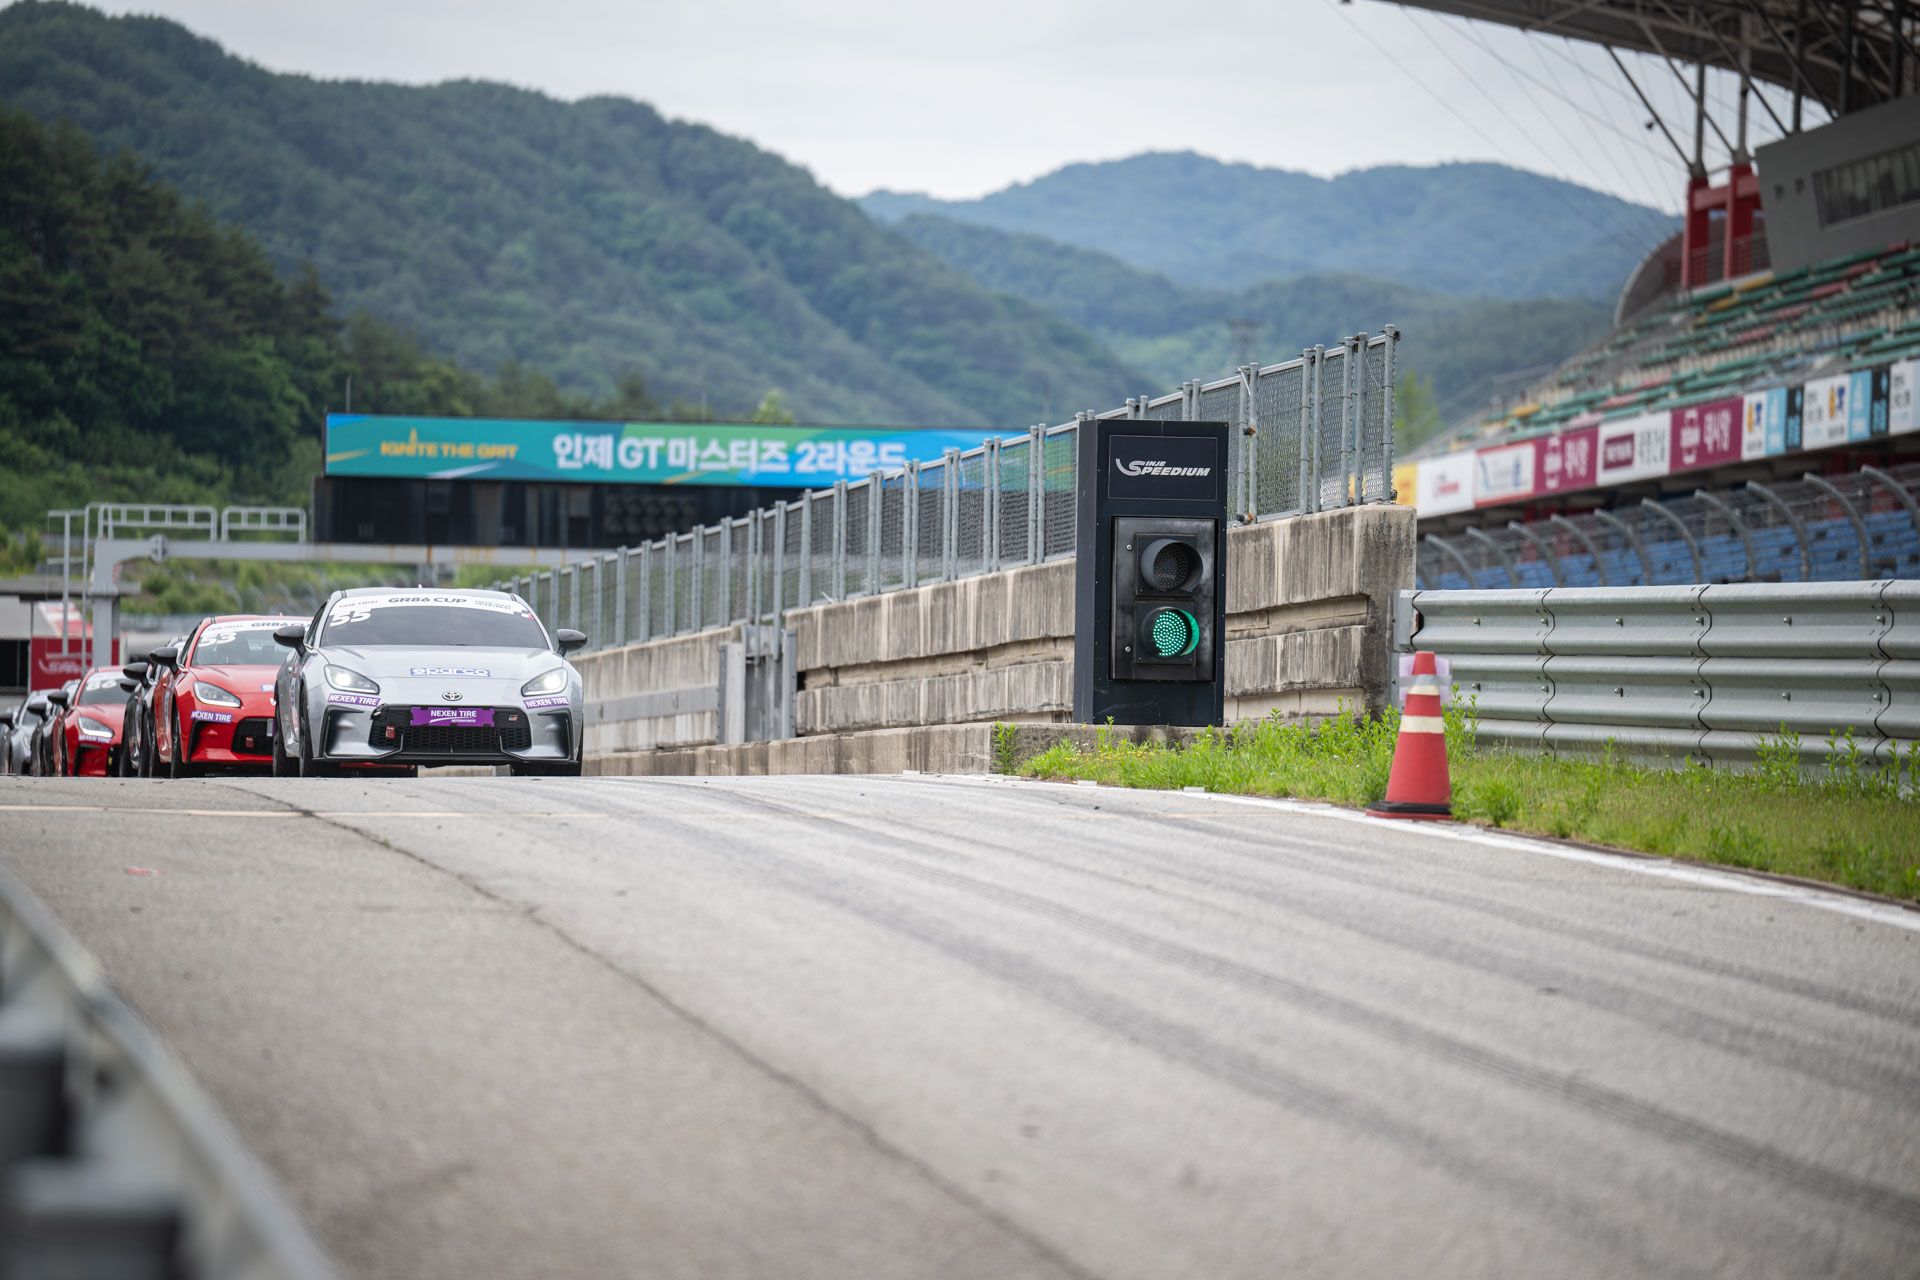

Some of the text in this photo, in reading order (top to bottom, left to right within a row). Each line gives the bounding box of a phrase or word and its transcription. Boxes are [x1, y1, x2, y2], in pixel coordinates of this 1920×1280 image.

[441, 442, 474, 458] THE
[553, 432, 906, 476] 인제 GT 마스터즈 2라운드
[1115, 458, 1211, 477] SPEEDIUM
[329, 608, 372, 627] 55
[412, 668, 489, 676] sparco
[328, 694, 379, 706] NEXEN TIRE
[525, 696, 569, 708] NEXEN TIRE
[191, 710, 232, 722] NEXEN TIRE
[430, 709, 477, 718] NEXEN TIRE
